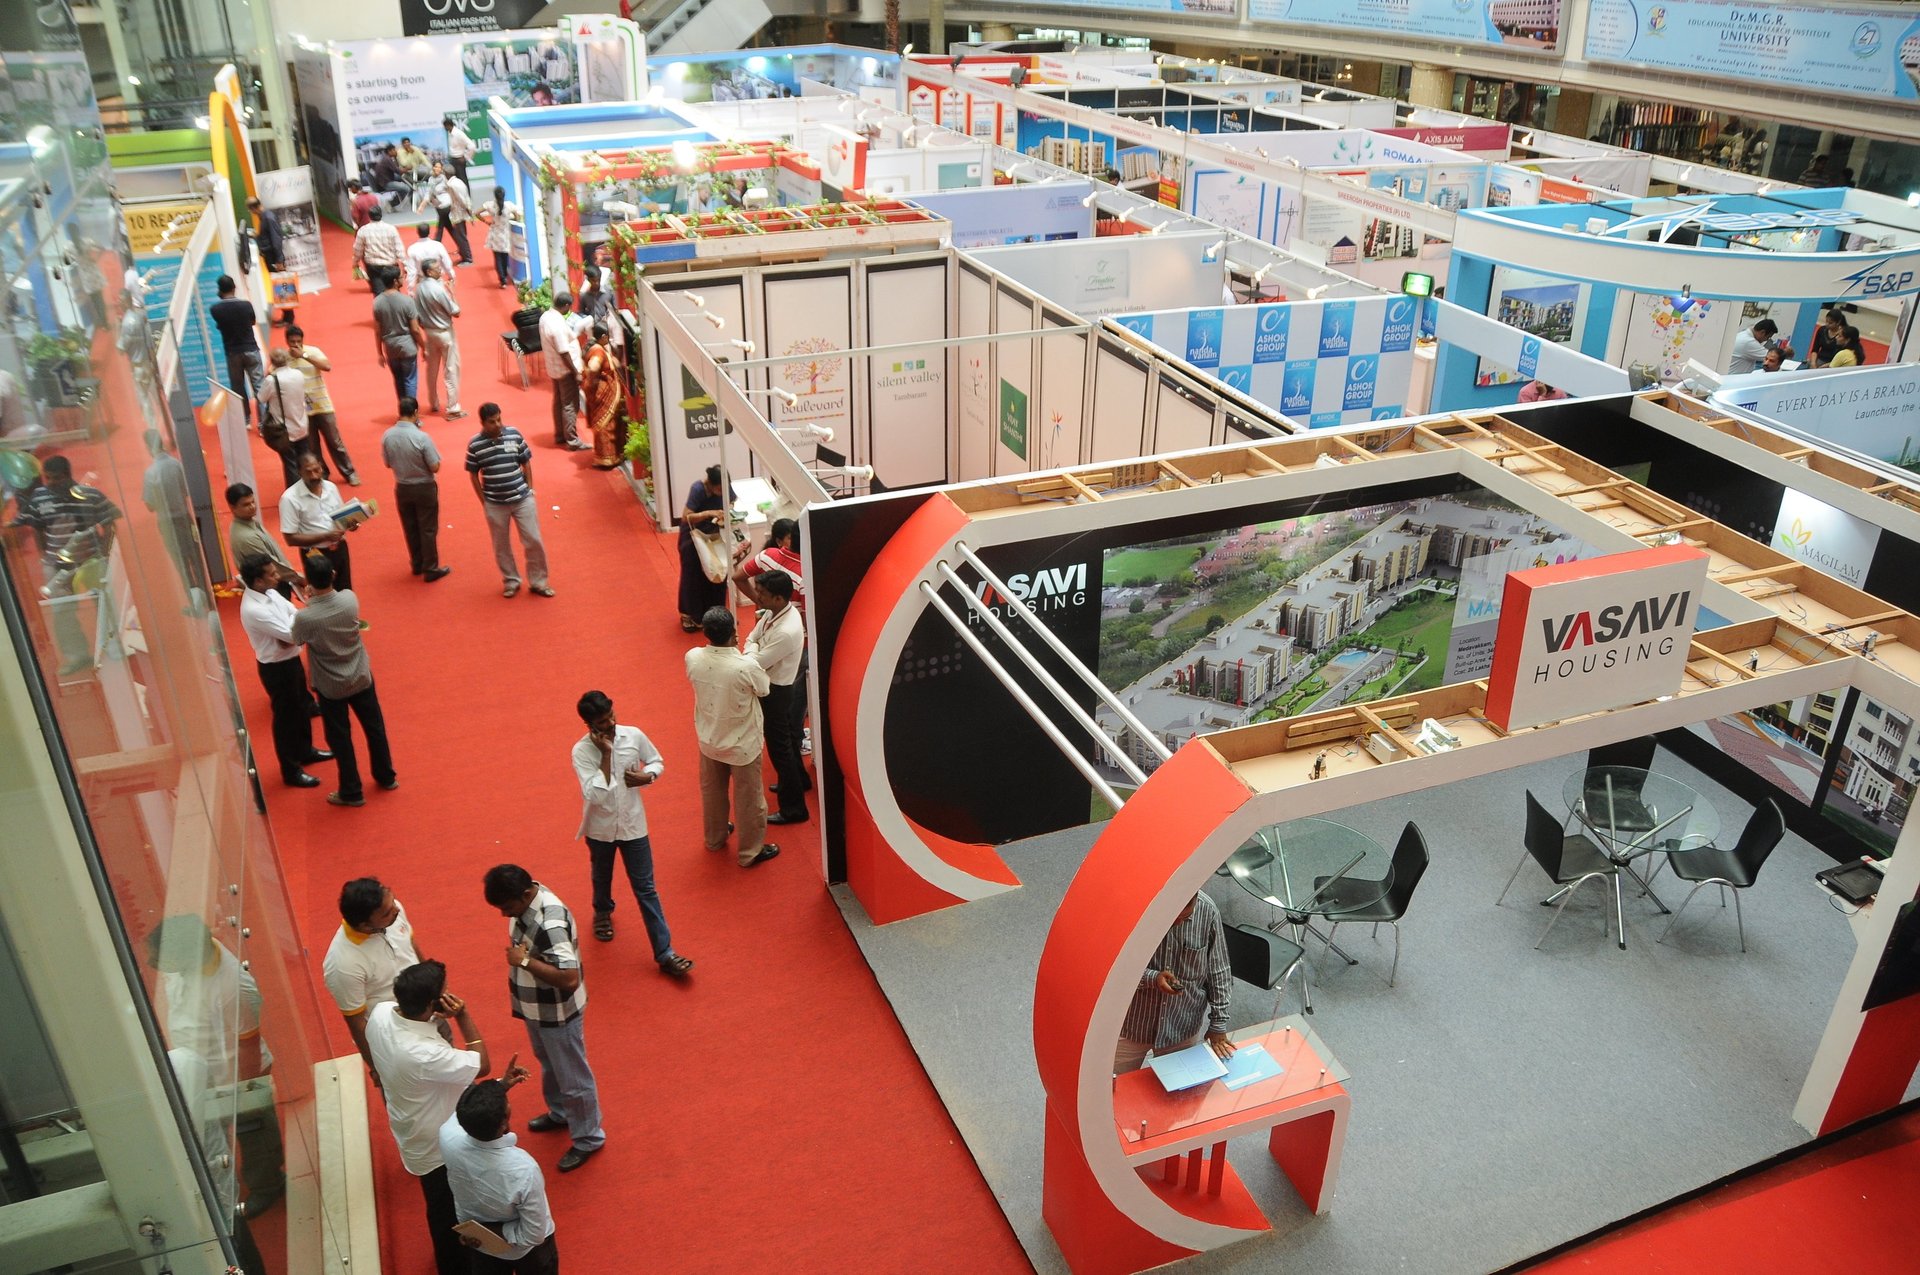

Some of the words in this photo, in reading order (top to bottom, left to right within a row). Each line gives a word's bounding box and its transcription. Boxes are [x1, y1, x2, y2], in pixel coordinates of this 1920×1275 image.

[429, 18, 460, 29] ITALIAN
[460, 15, 497, 27] FASHION
[1730, 11, 1787, 26] Dr.M.G.R.
[1688, 19, 1735, 29] EDUCATIONAL
[1792, 28, 1831, 39] INSTITUTE
[1720, 30, 1792, 48] UNIVERSITY
[356, 76, 398, 89] starting
[400, 75, 425, 85] from
[1424, 135, 1442, 145] AXIS
[1443, 134, 1465, 144] BANK
[1362, 197, 1393, 213] PROPERTIES
[128, 213, 145, 230] 10
[1863, 271, 1914, 295] S&P
[1384, 323, 1412, 334] ASHOK
[1256, 333, 1286, 344] ASHOK
[1383, 332, 1411, 342] GROUP
[1256, 342, 1285, 353] GROUP
[1290, 361, 1311, 369] ASHOK
[1520, 354, 1537, 364] ASHOK
[1520, 360, 1536, 370] GROUP
[877, 375, 907, 389] silent
[910, 370, 943, 386] valley
[1346, 381, 1374, 391] ASHOK
[1345, 390, 1373, 400] GROUP
[1776, 395, 1817, 414] EVERY
[1819, 391, 1847, 407] DAY
[1848, 389, 1861, 403] IS
[1861, 388, 1870, 401] A
[1873, 381, 1916, 399] BRAND
[781, 397, 844, 415] boulevard
[1855, 404, 1898, 420] Launching
[1901, 403, 1915, 413] the
[690, 413, 718, 424] LOTU
[1316, 413, 1336, 421] ASHOK
[694, 421, 719, 431] PON
[1801, 544, 1861, 580] MAGILAM
[1542, 590, 1691, 654] VASAVI
[1458, 641, 1493, 653] Medavakkam,
[1533, 636, 1675, 684] HOUSING
[1453, 668, 1467, 676] Cost:
